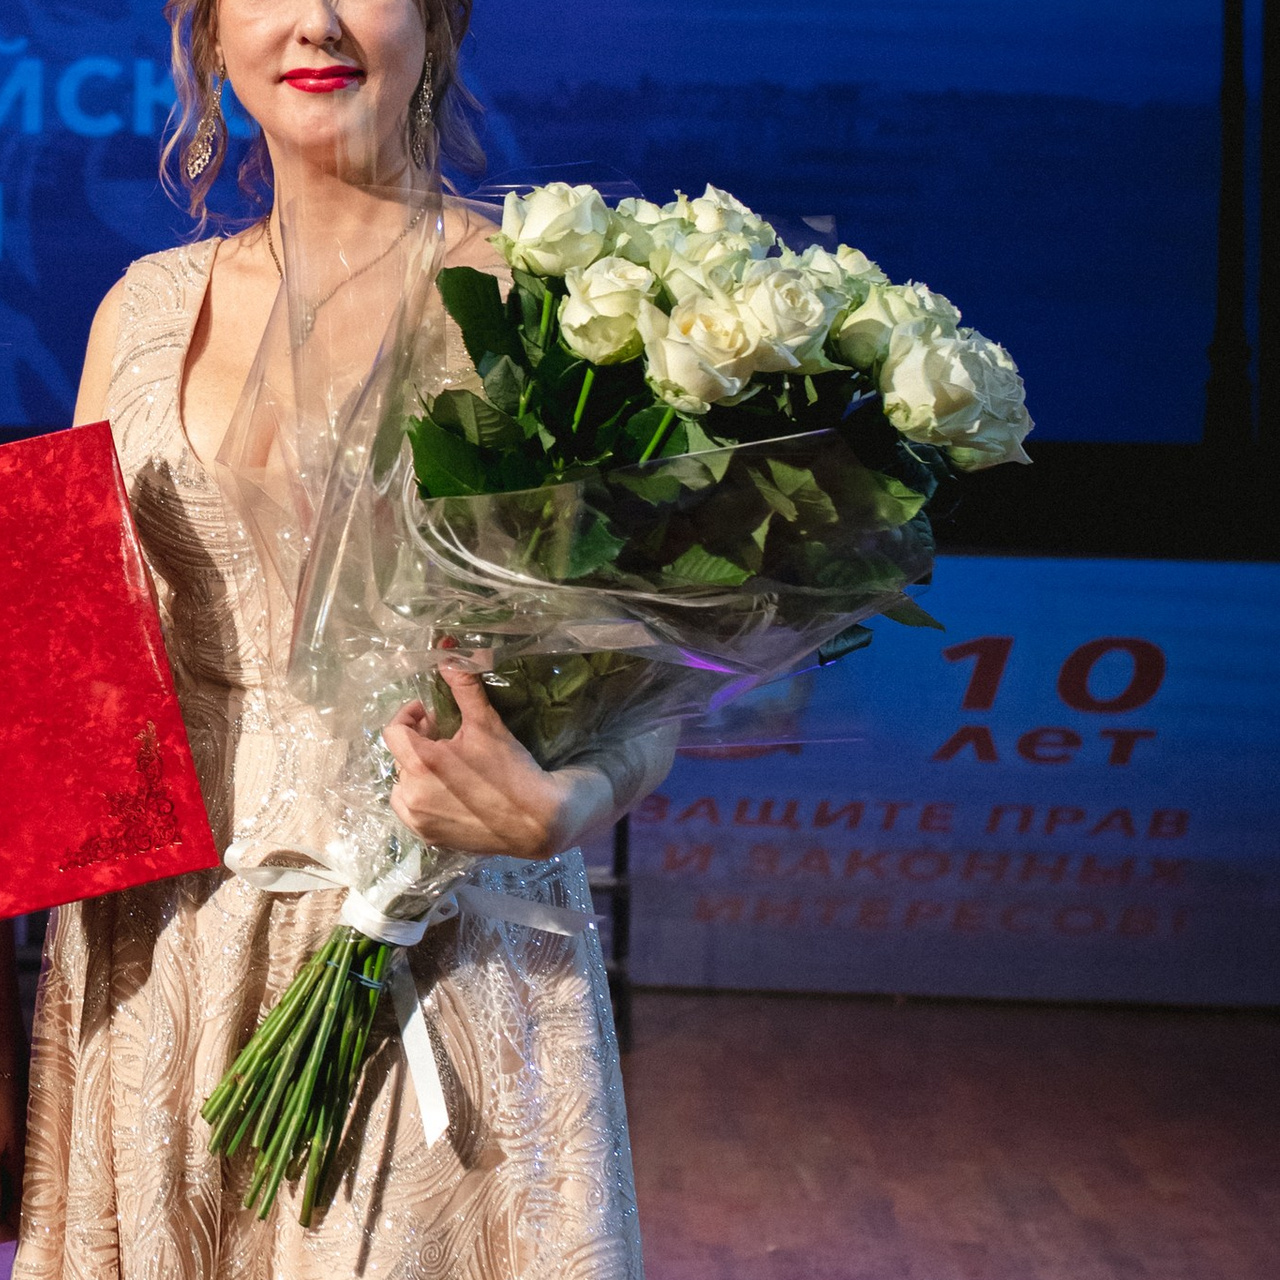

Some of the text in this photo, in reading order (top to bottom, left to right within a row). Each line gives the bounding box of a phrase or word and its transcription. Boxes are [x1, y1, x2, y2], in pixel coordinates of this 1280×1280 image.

[941, 635, 1167, 714] 10
[637, 794, 1191, 839] ЗАЩИТЕ ПРАВ
[745, 842, 1190, 888] ЗАКОННЫХ
